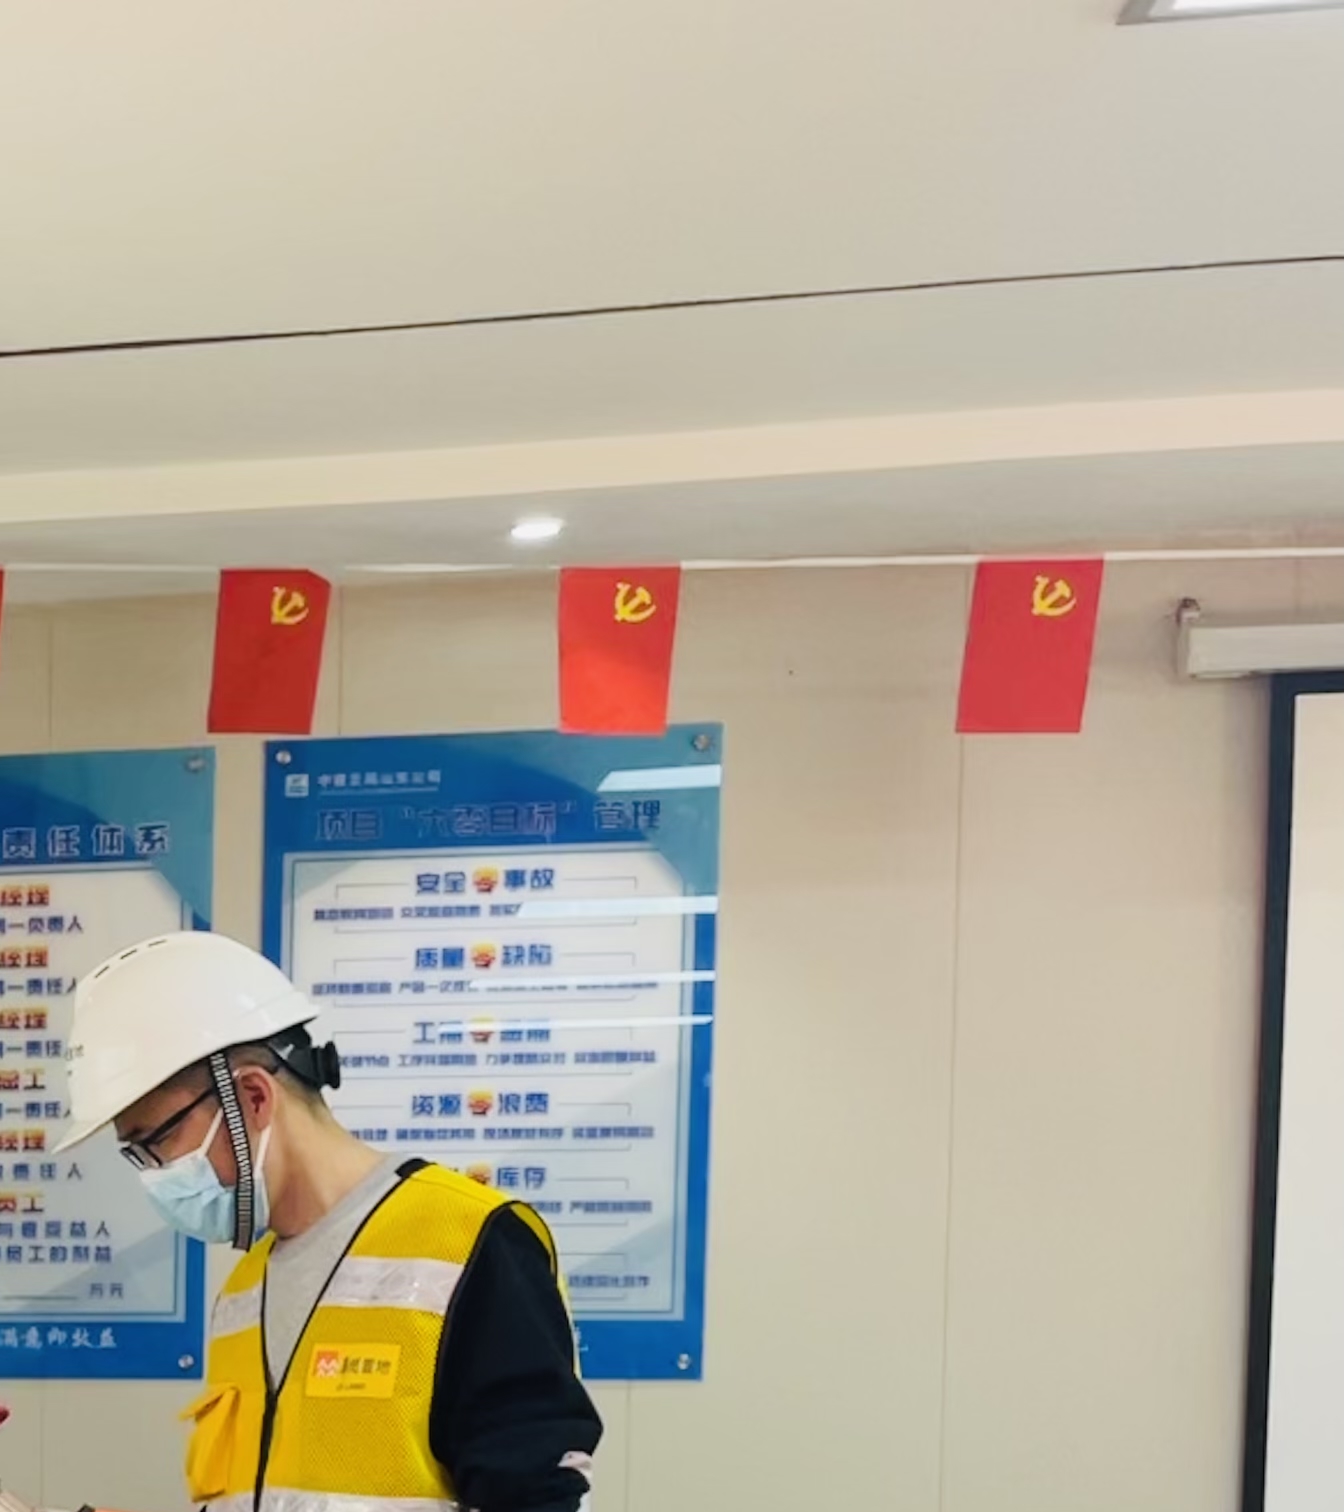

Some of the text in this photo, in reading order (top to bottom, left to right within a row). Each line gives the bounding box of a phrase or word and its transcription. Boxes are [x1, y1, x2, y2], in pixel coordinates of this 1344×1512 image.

[415, 865, 556, 894] 安全零事故
[414, 943, 552, 970] 质量零缺陷
[411, 1089, 550, 1117] 资源零浪费
[450, 1163, 548, 1190] 零库存
